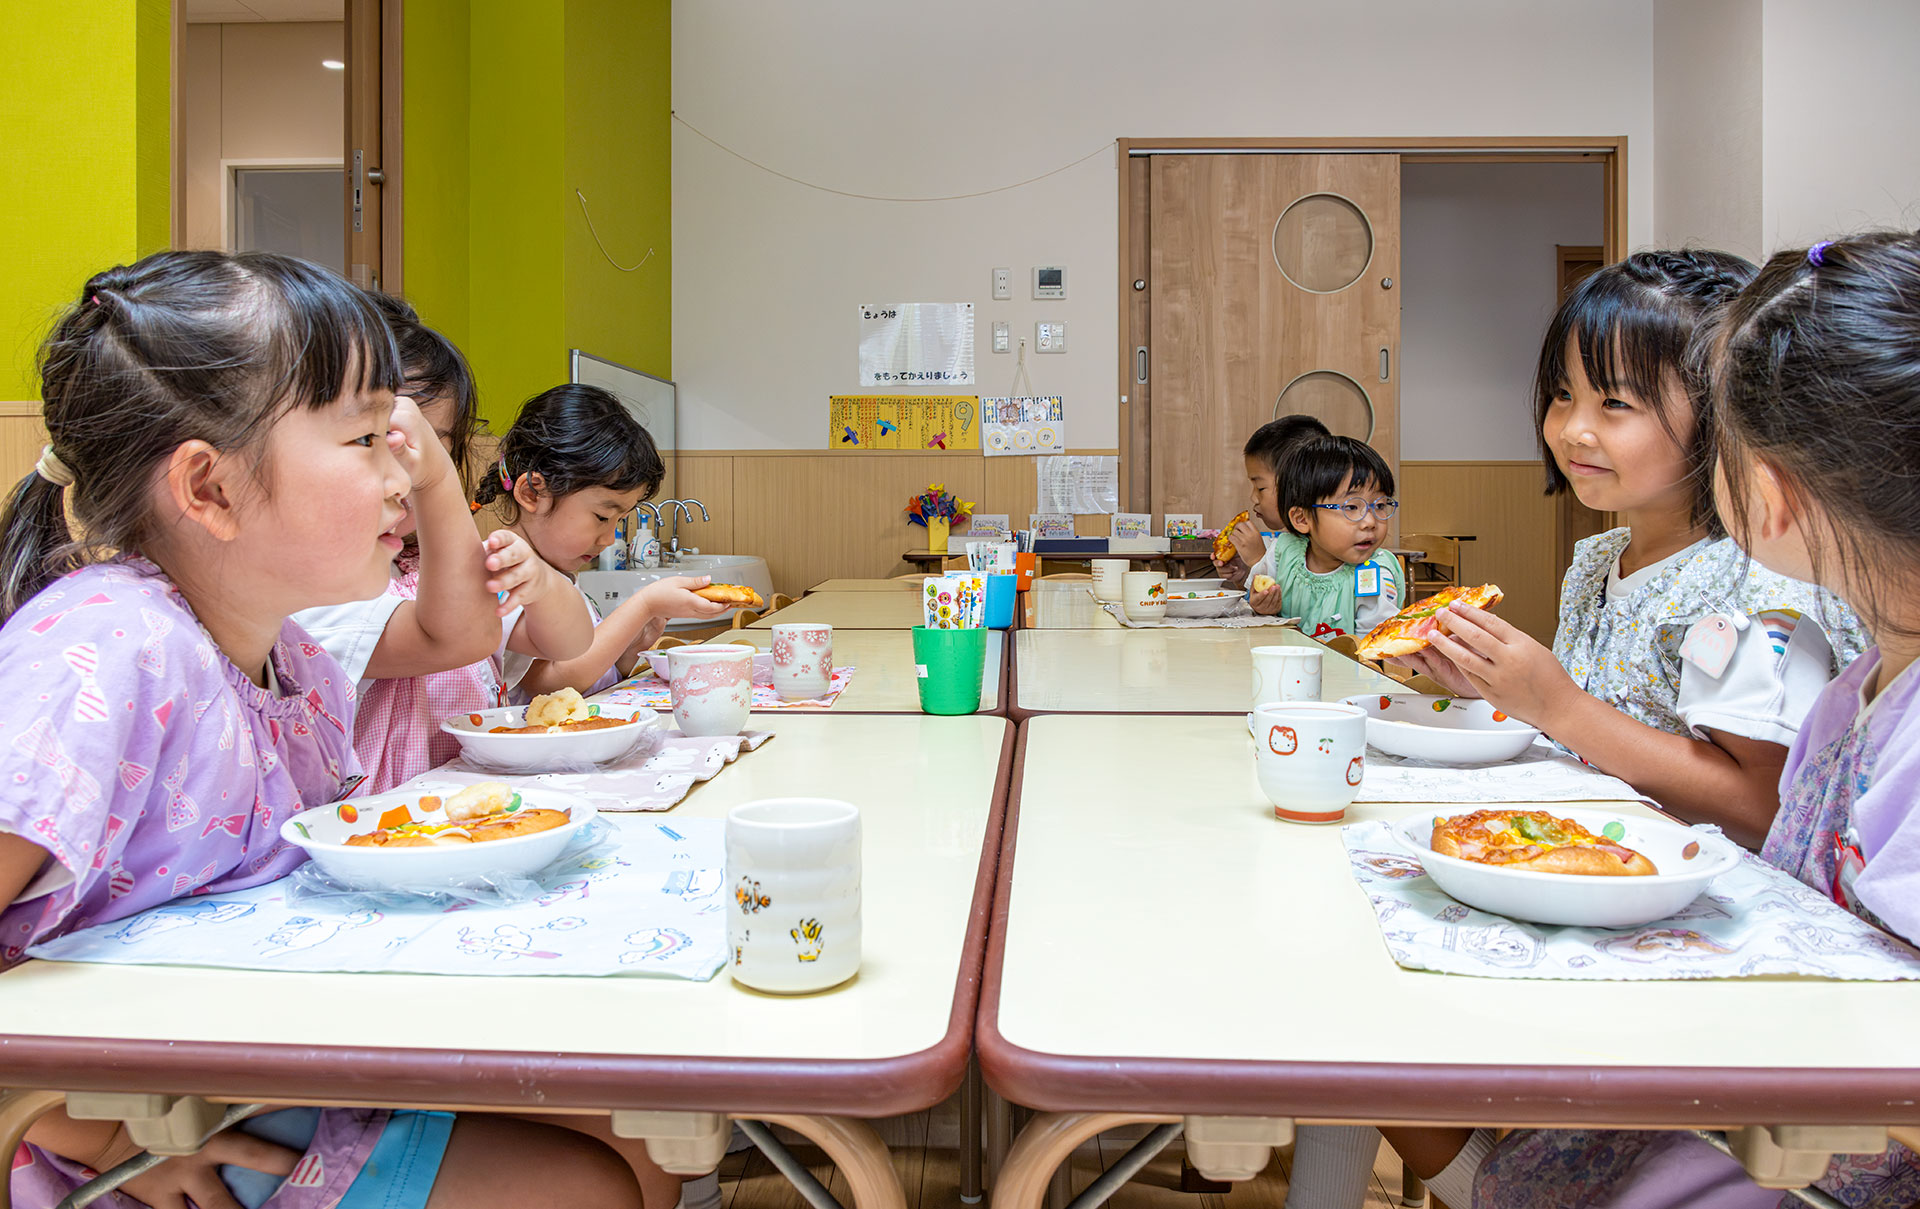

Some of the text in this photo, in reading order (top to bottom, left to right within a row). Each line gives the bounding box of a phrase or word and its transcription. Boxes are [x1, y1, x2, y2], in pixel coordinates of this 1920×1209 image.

[863, 310, 897, 320] きょうは
[874, 371, 968, 381] をもってかえりましょう
[994, 437, 1002, 445] 9
